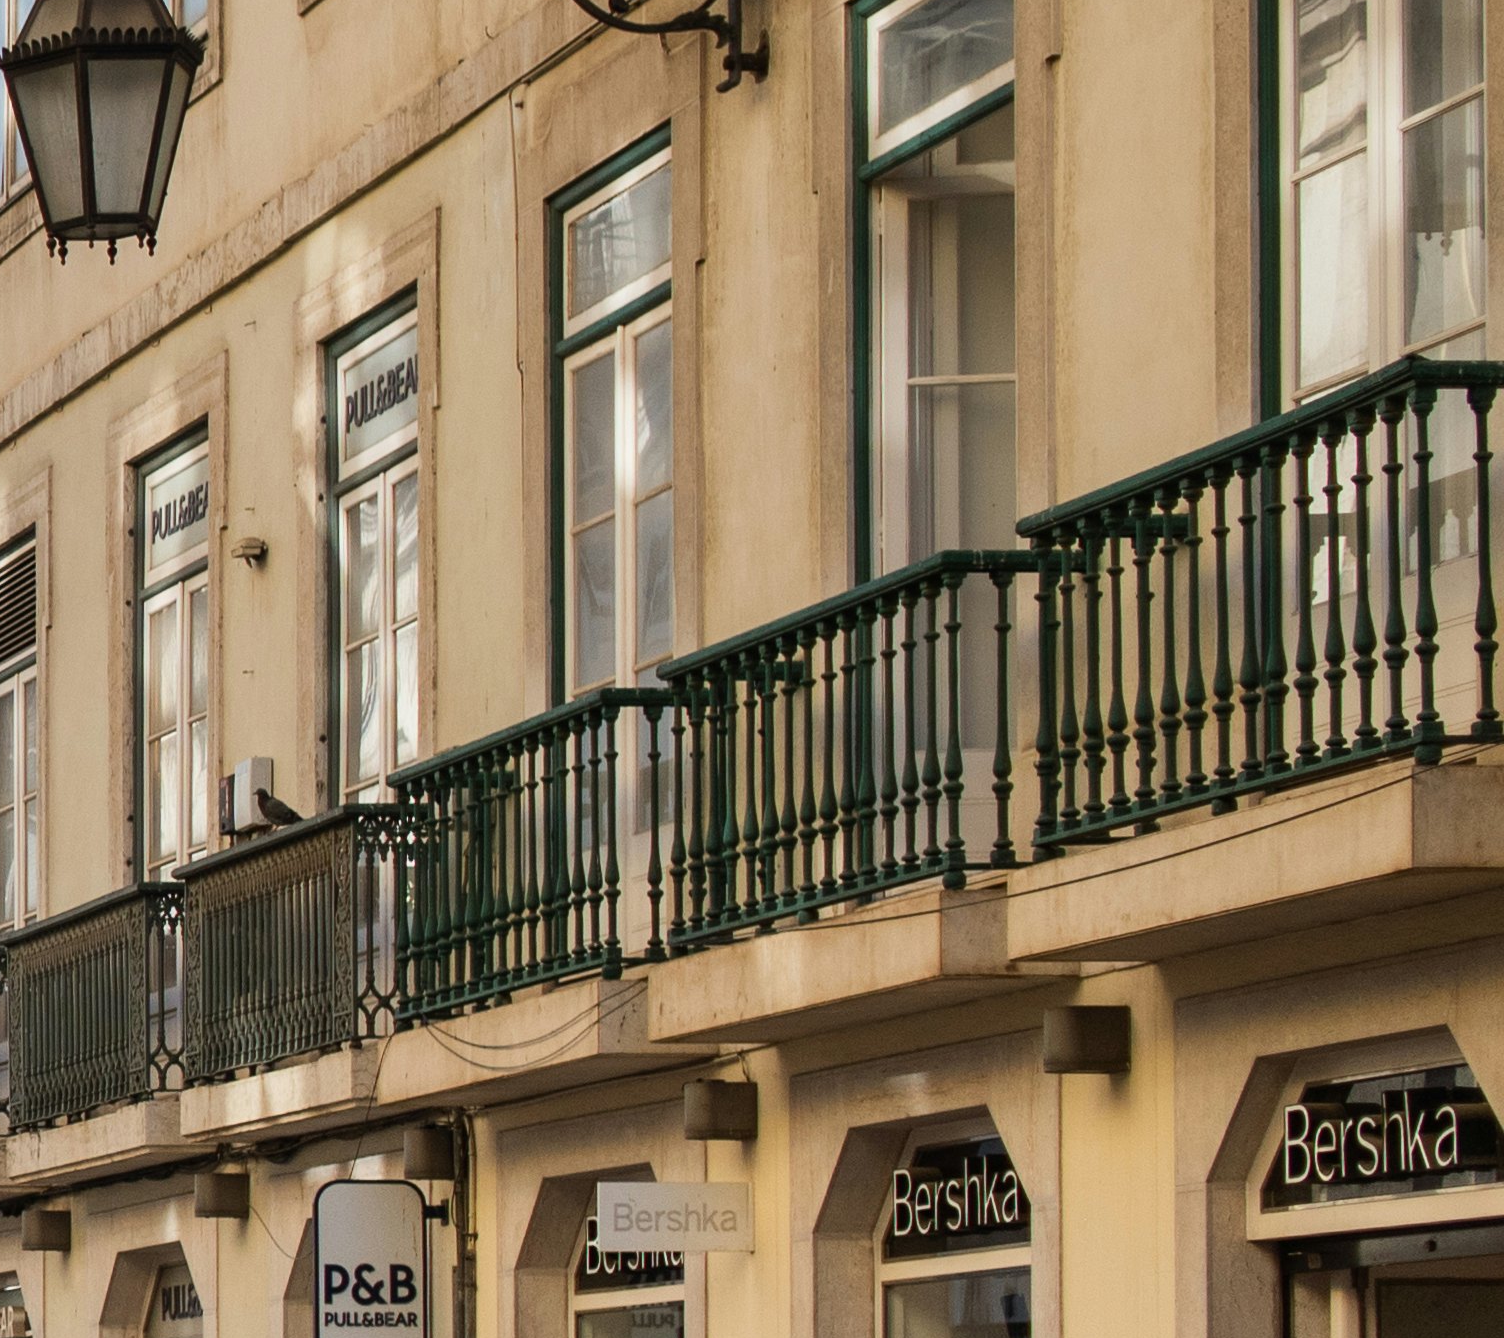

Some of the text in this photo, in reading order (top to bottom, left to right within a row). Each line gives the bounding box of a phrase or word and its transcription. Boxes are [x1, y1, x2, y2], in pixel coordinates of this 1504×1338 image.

[1282, 1089, 1460, 1185] Bershka
[614, 1203, 737, 1232] Bershka
[892, 1155, 1020, 1237] Bershka
[324, 1263, 418, 1306] P&B
[324, 1312, 418, 1328] PULL&BEAR
